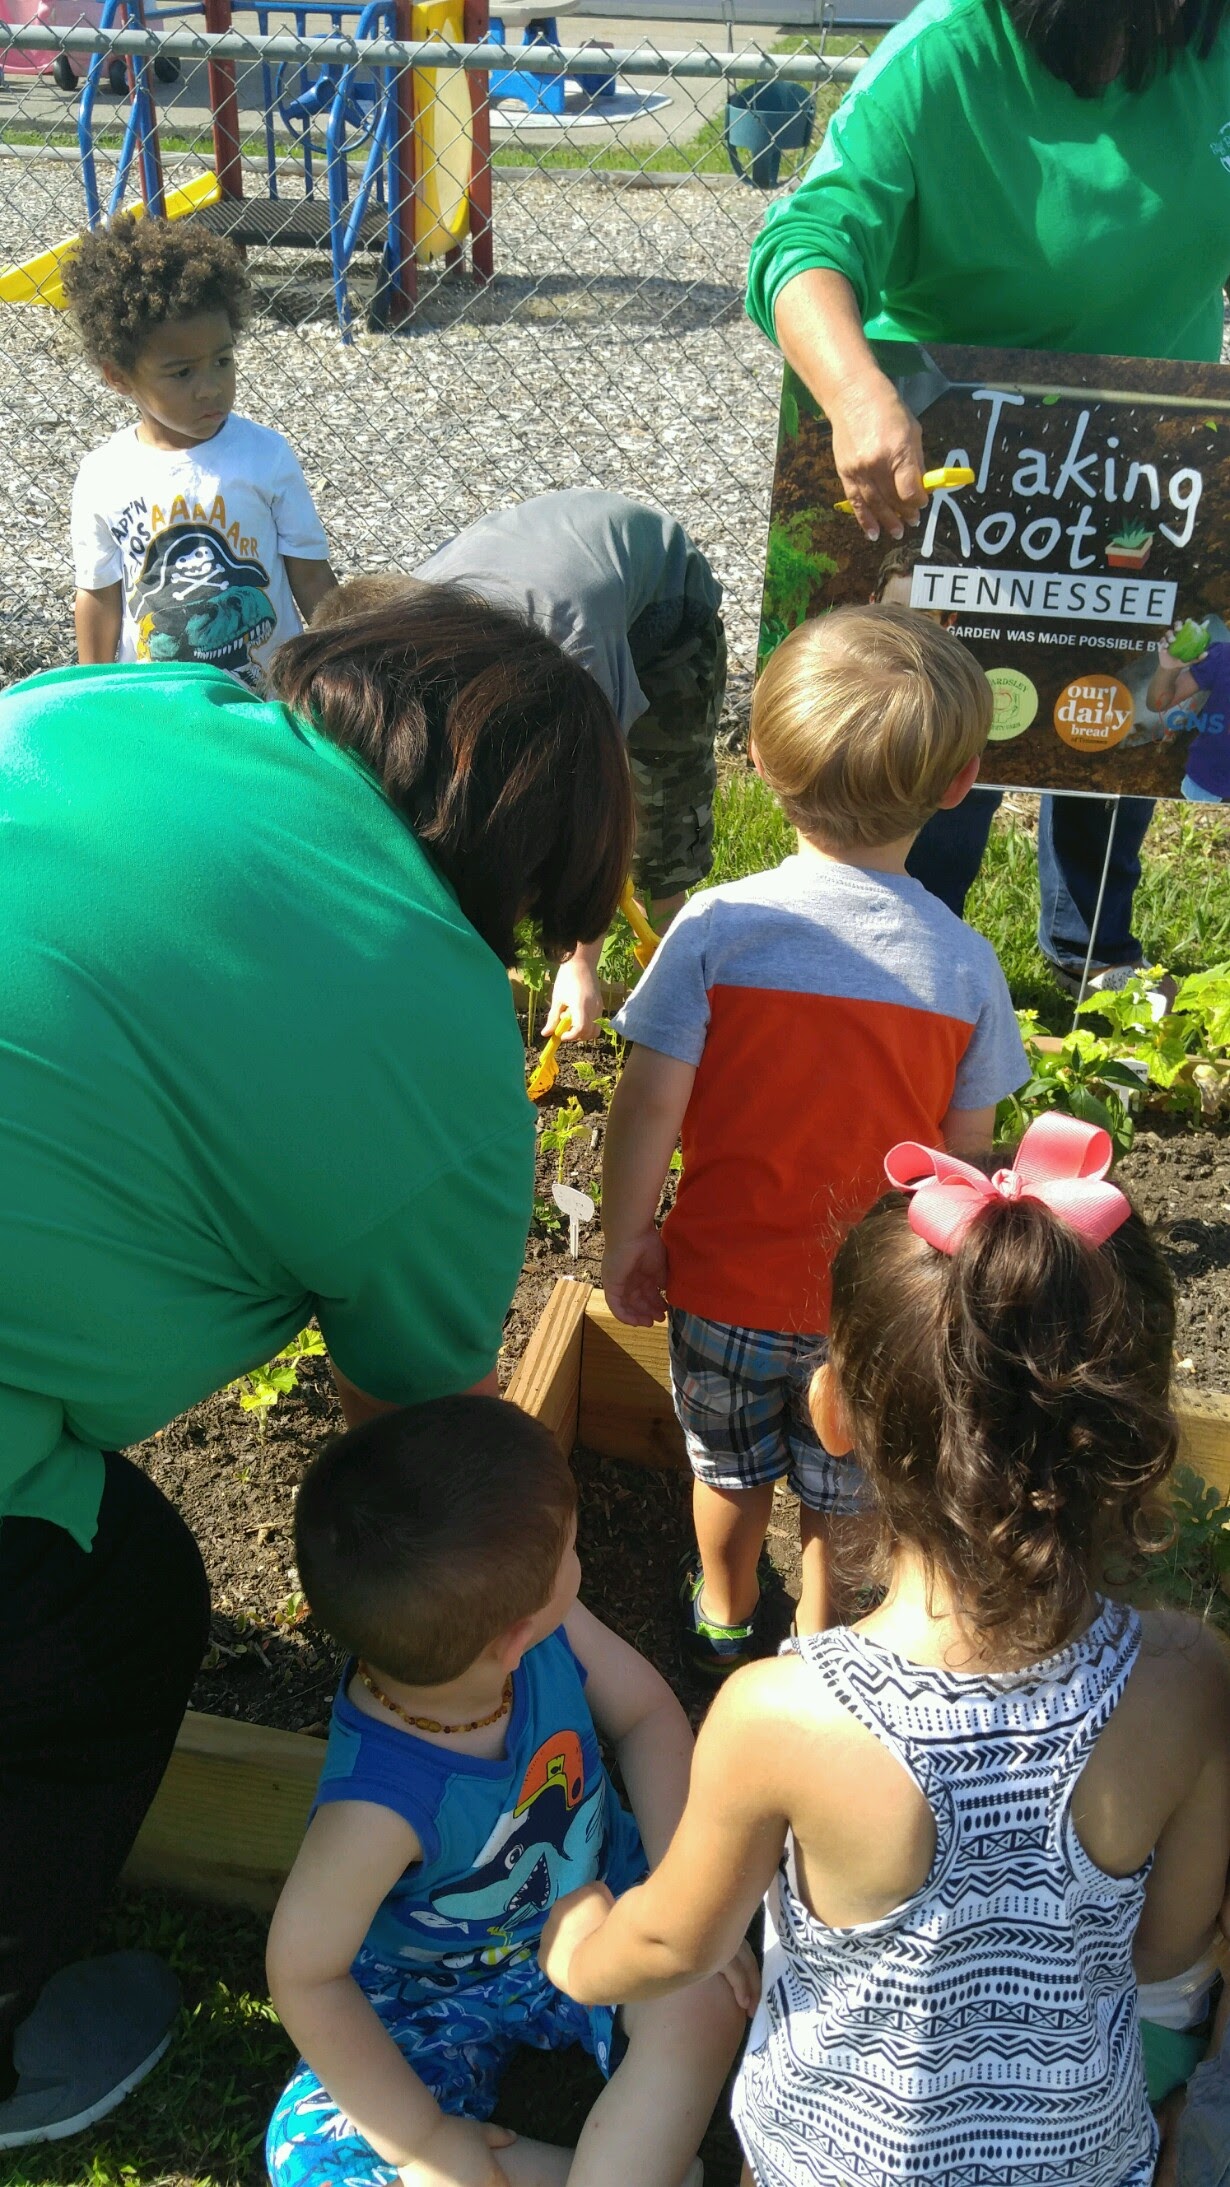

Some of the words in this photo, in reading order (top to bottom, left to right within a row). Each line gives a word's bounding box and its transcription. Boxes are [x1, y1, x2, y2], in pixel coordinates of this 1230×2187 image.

[972, 389, 1203, 548] Taking
[111, 497, 148, 546] APT'N
[921, 449, 1097, 569] Root
[923, 573, 1166, 617] TENNESSEE
[947, 626, 1000, 640] GARDEN
[1007, 630, 1035, 643] WAS
[1038, 633, 1076, 646] MADE
[1079, 636, 1144, 651] POSSIBLE
[990, 678, 1028, 693] ARDSLEY
[1067, 685, 1109, 700] our
[1057, 686, 1131, 731] daily
[1167, 710, 1225, 734] CNS
[1071, 724, 1109, 738] bread
